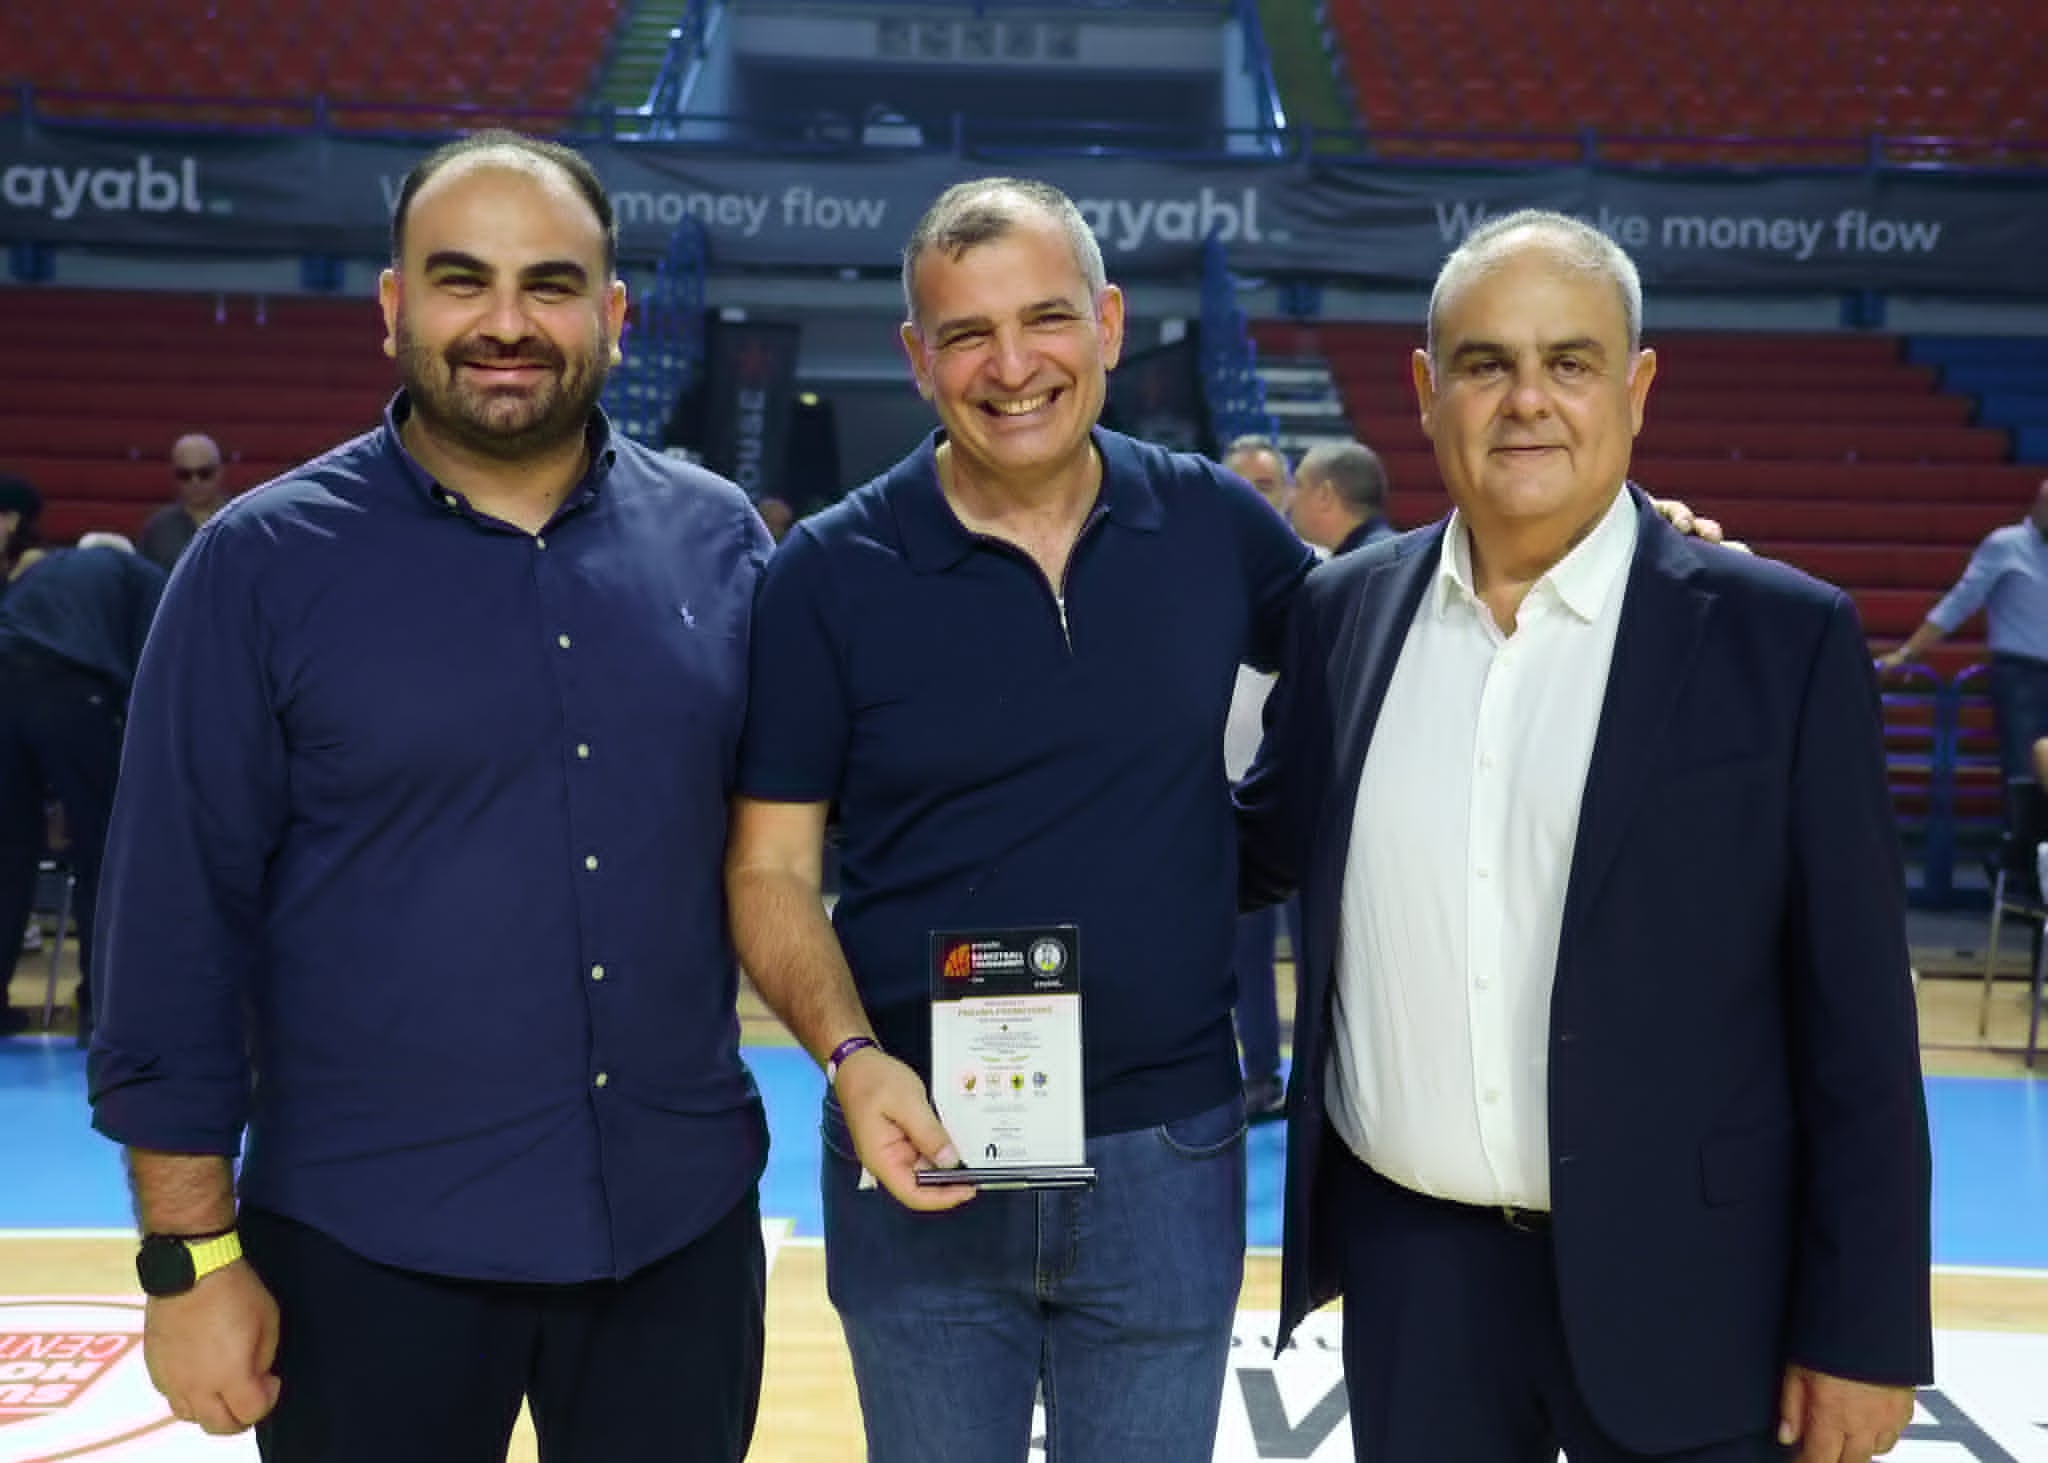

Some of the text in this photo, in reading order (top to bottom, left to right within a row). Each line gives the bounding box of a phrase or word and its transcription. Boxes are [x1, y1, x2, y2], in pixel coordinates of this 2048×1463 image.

[611, 185, 888, 237] money flow
[1661, 214, 1823, 261] money
[1834, 208, 1942, 252] flow
[736, 390, 765, 500] OUSE
